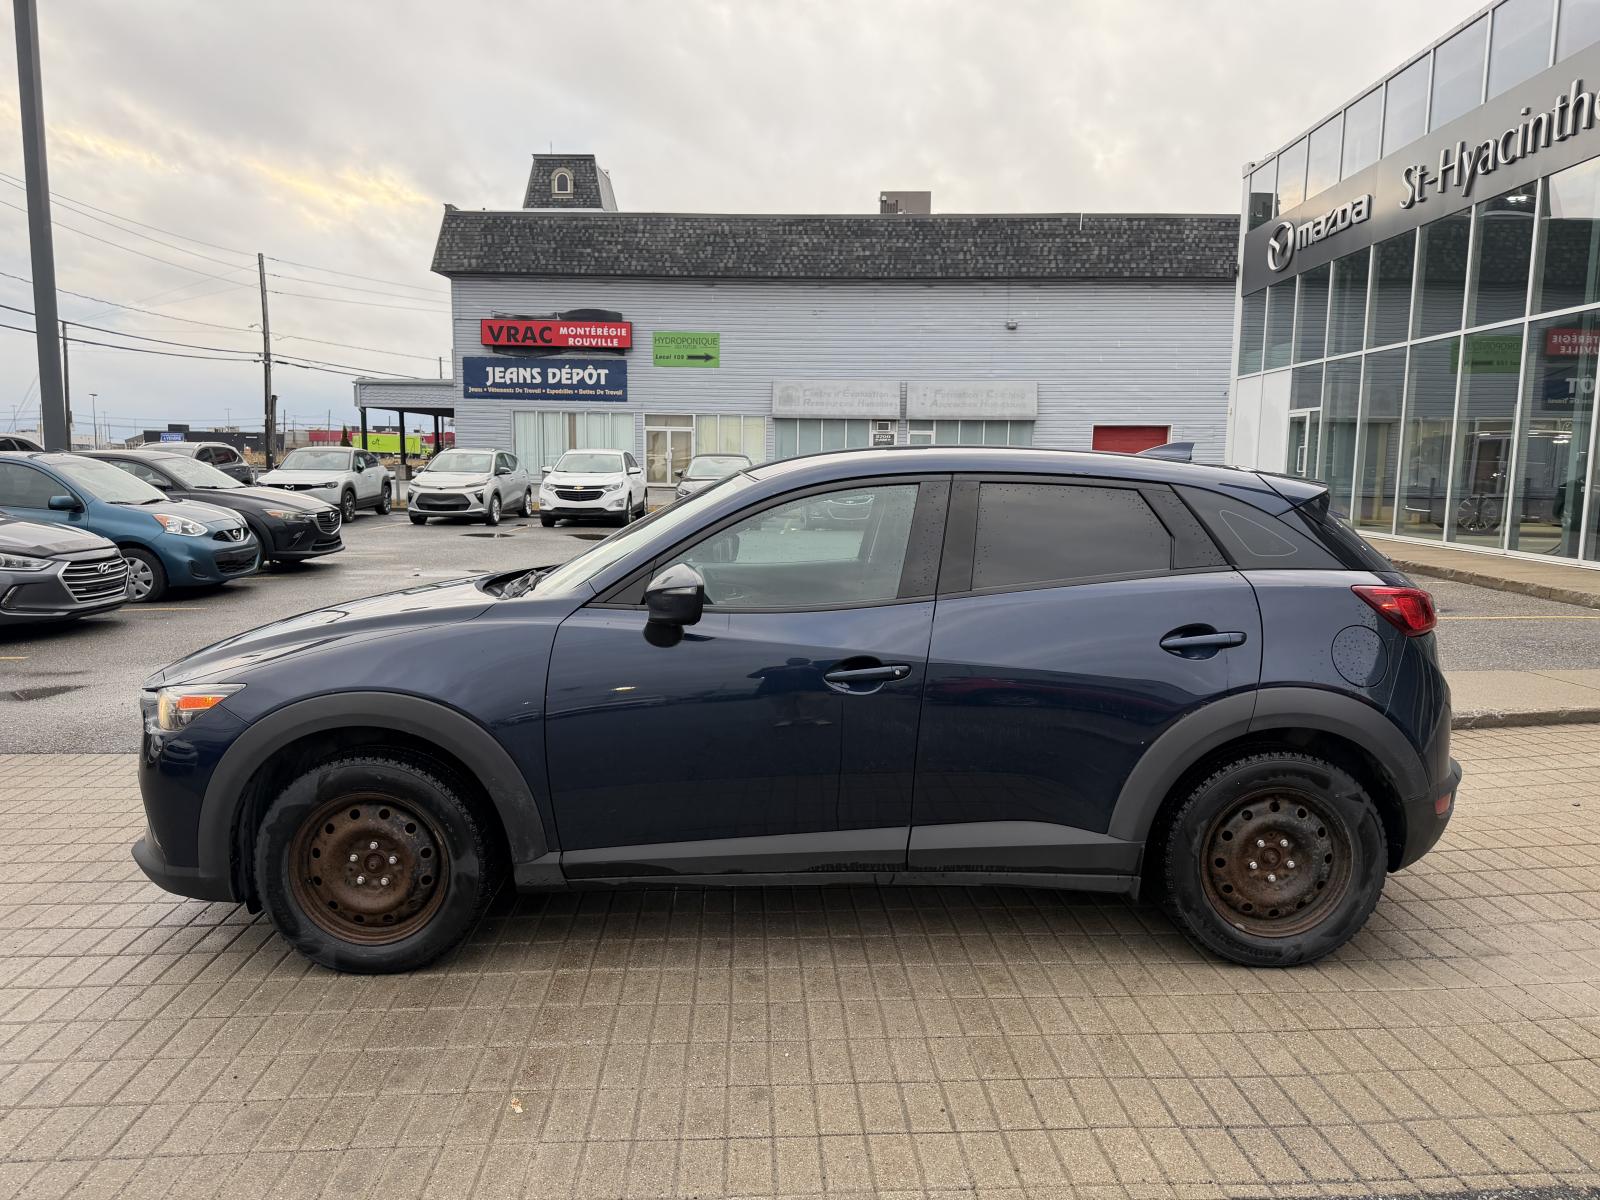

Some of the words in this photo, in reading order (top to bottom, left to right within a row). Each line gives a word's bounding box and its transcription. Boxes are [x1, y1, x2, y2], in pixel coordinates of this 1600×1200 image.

[1296, 194, 1370, 250] mazda
[488, 325, 553, 343] VRAC
[559, 326, 627, 336] MONTÉRÉGIE
[568, 338, 619, 346] ROUVILLE
[654, 336, 719, 346] HYDROPONIQUE
[486, 366, 542, 386] JEANS
[547, 364, 609, 385] DÉPÔT
